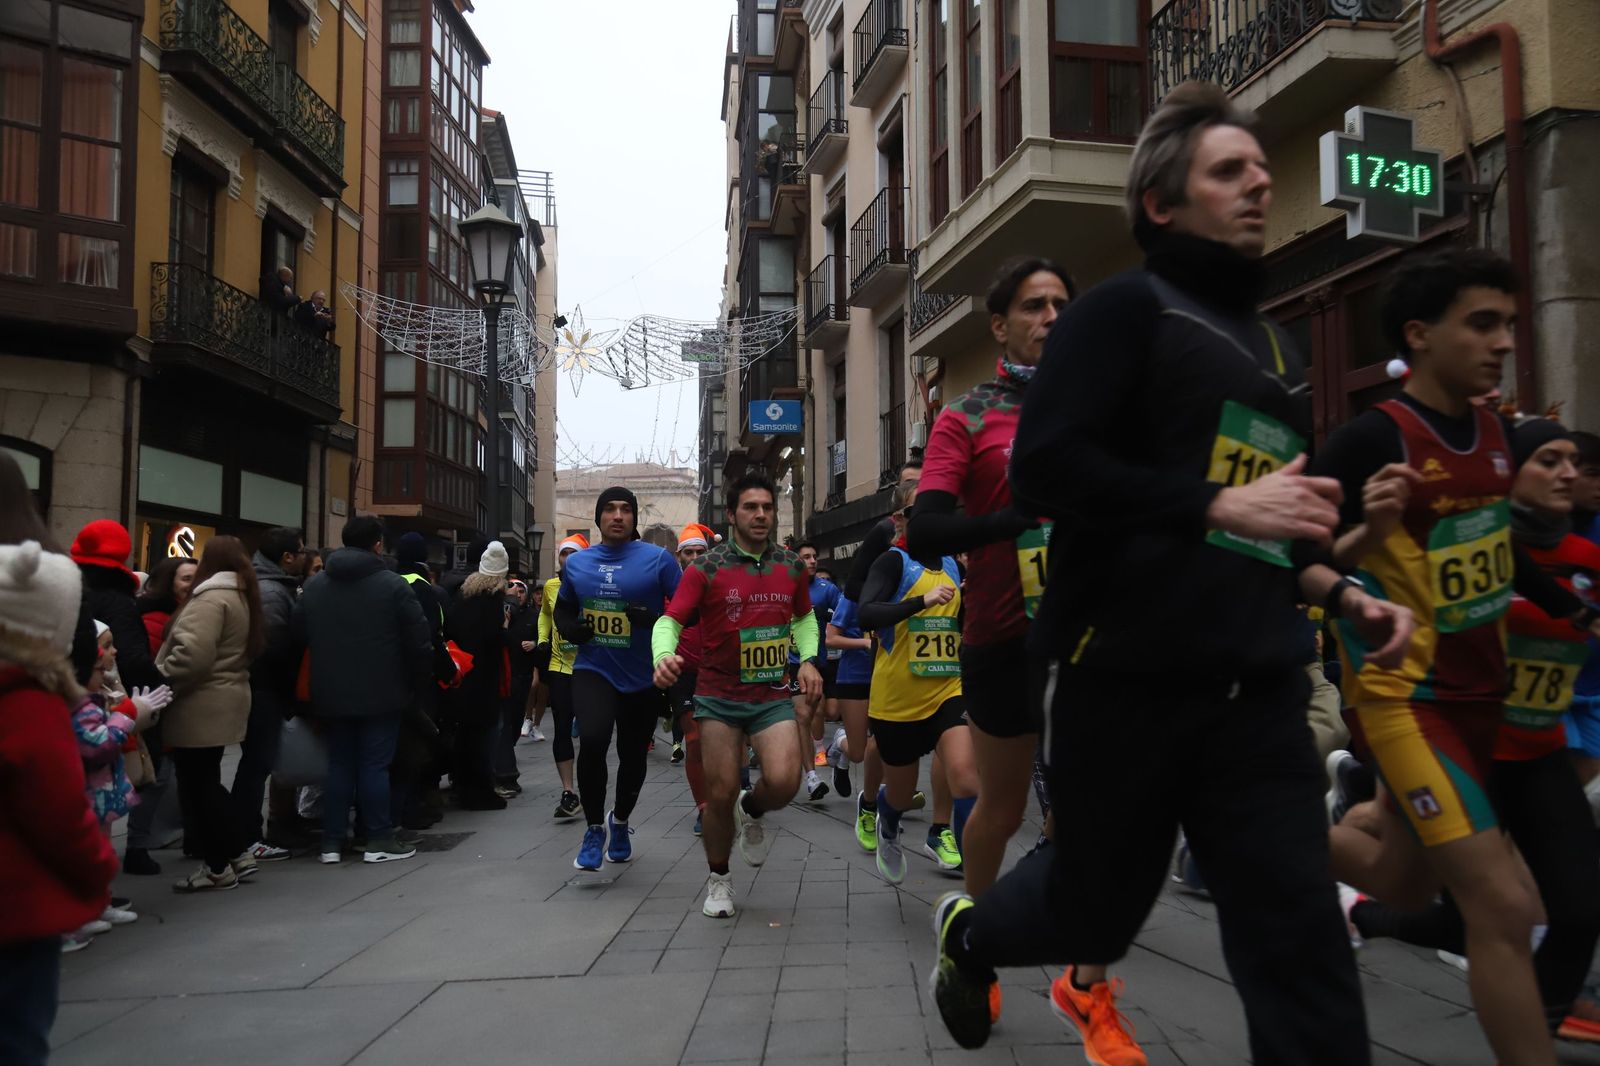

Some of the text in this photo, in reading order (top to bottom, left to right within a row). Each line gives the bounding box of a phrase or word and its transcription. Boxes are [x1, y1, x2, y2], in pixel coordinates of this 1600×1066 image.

[1346, 153, 1431, 196] 17:30
[753, 423, 798, 431] Samsonite
[1440, 541, 1508, 600] 630
[748, 593, 768, 602] APIS
[585, 613, 623, 635] 808
[742, 644, 785, 668] 1000
[916, 634, 956, 657] 218
